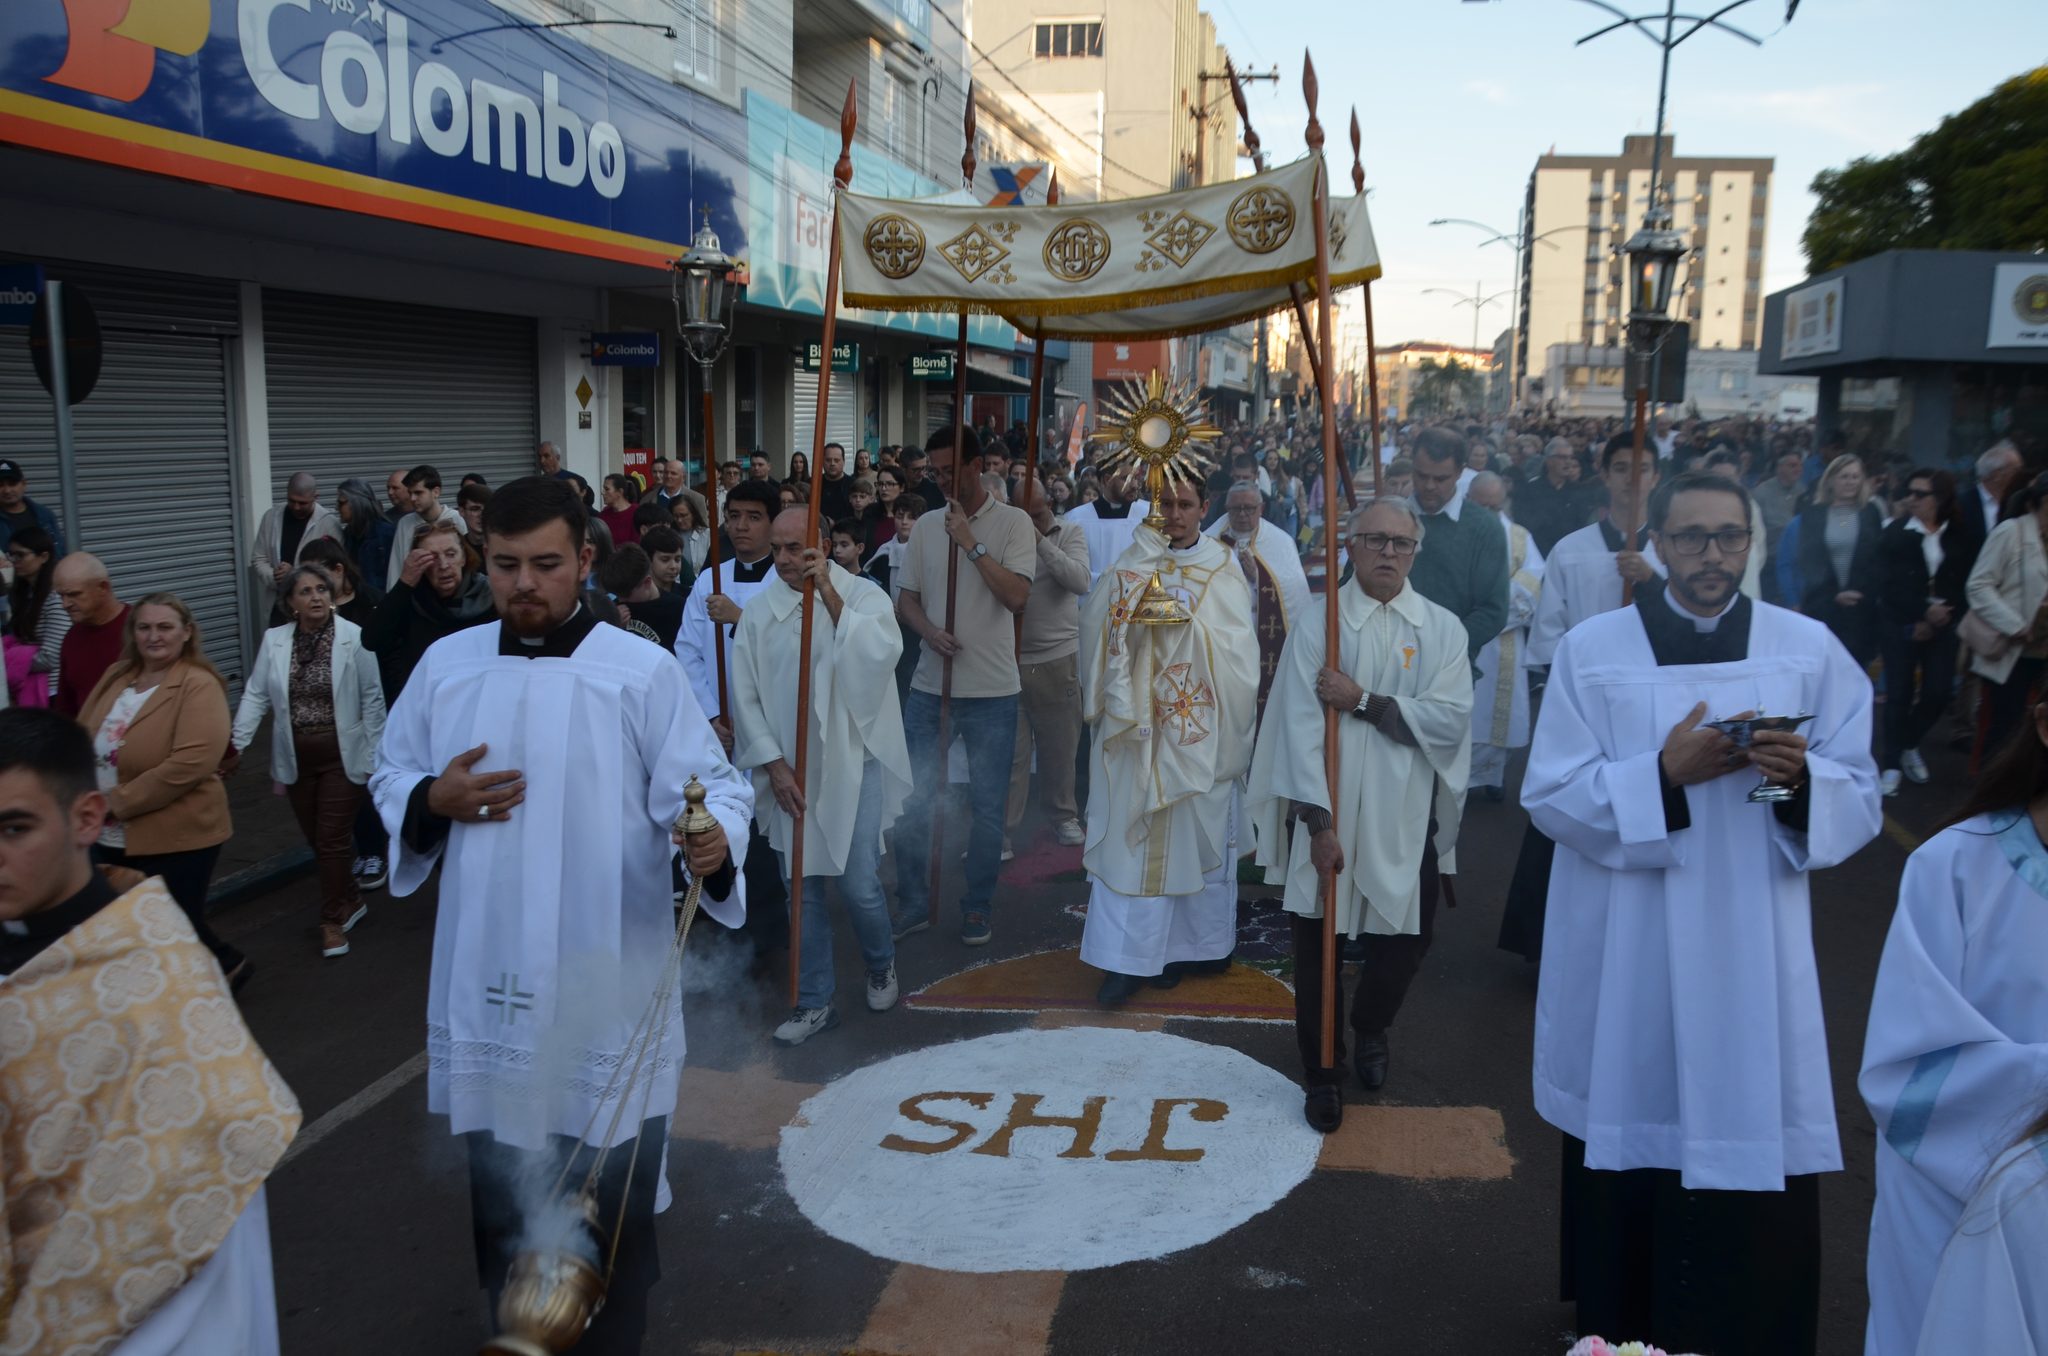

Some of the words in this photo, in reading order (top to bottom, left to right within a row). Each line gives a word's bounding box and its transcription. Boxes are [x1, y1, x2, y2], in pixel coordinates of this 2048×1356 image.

[237, 0, 626, 198] Colombo
[796, 191, 833, 251] Far
[606, 344, 655, 356] Colombo
[636, 452, 647, 465] TEM
